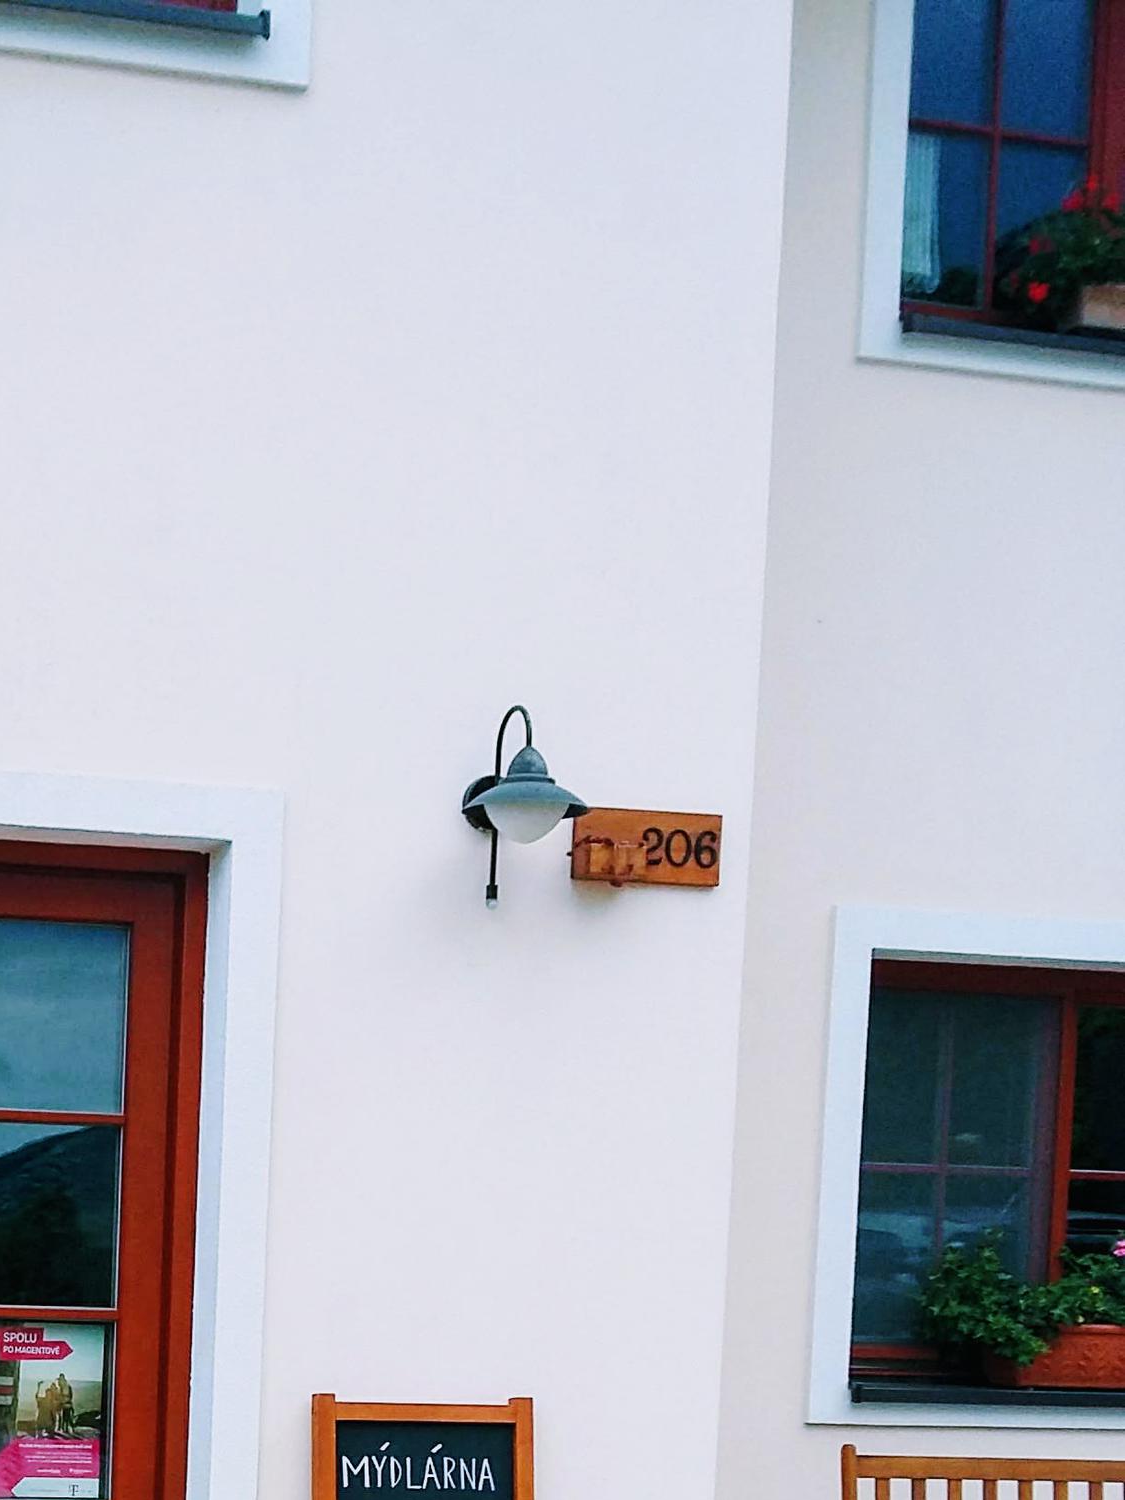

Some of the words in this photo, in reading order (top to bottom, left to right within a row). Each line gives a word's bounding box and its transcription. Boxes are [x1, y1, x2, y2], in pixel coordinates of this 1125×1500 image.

[642, 827, 718, 869] 206
[3, 1332, 37, 1343] SPOLU
[3, 1345, 14, 1353] PO
[342, 1441, 496, 1492] MÝDLÁRNA
